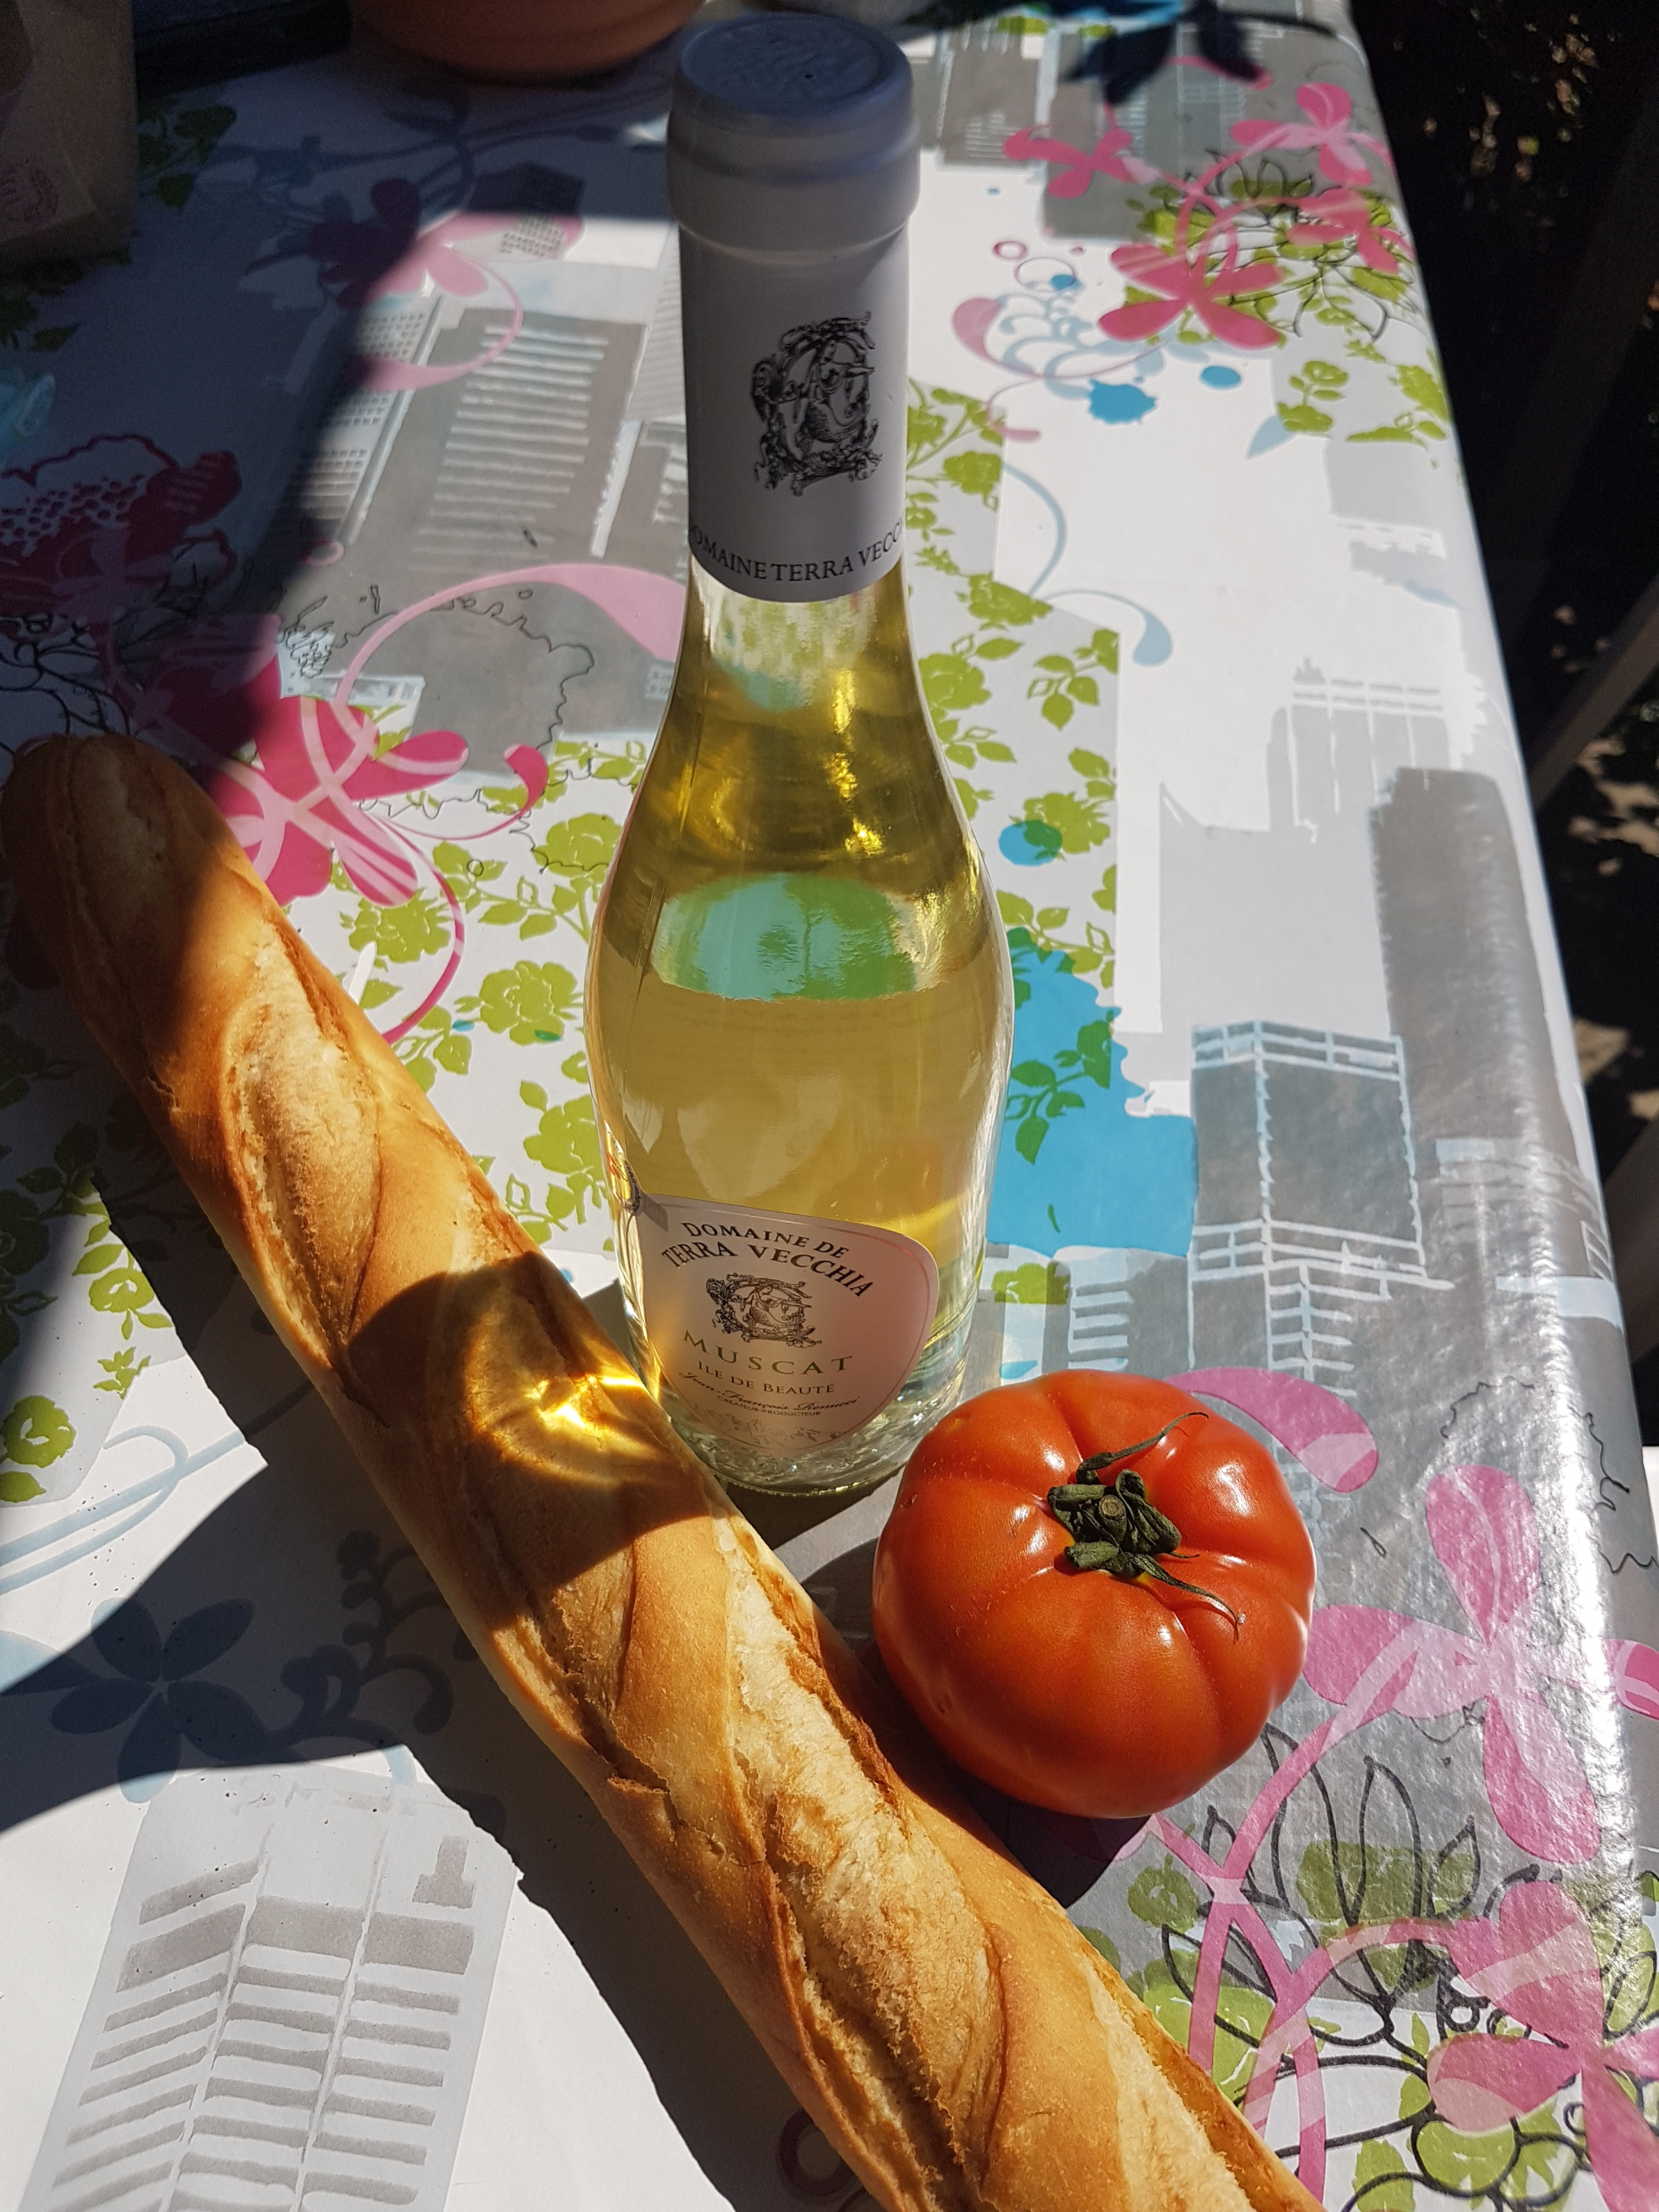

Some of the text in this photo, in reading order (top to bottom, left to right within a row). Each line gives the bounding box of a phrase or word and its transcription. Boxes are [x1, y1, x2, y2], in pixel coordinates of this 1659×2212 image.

[771, 557, 855, 582] TERRA
[681, 1222, 849, 1259] DOMAINE DE
[661, 1240, 874, 1297] TERRA VECCHIA
[683, 1330, 853, 1375] MUSCAT
[697, 1360, 834, 1395] ILE DE BEAUTÉ
